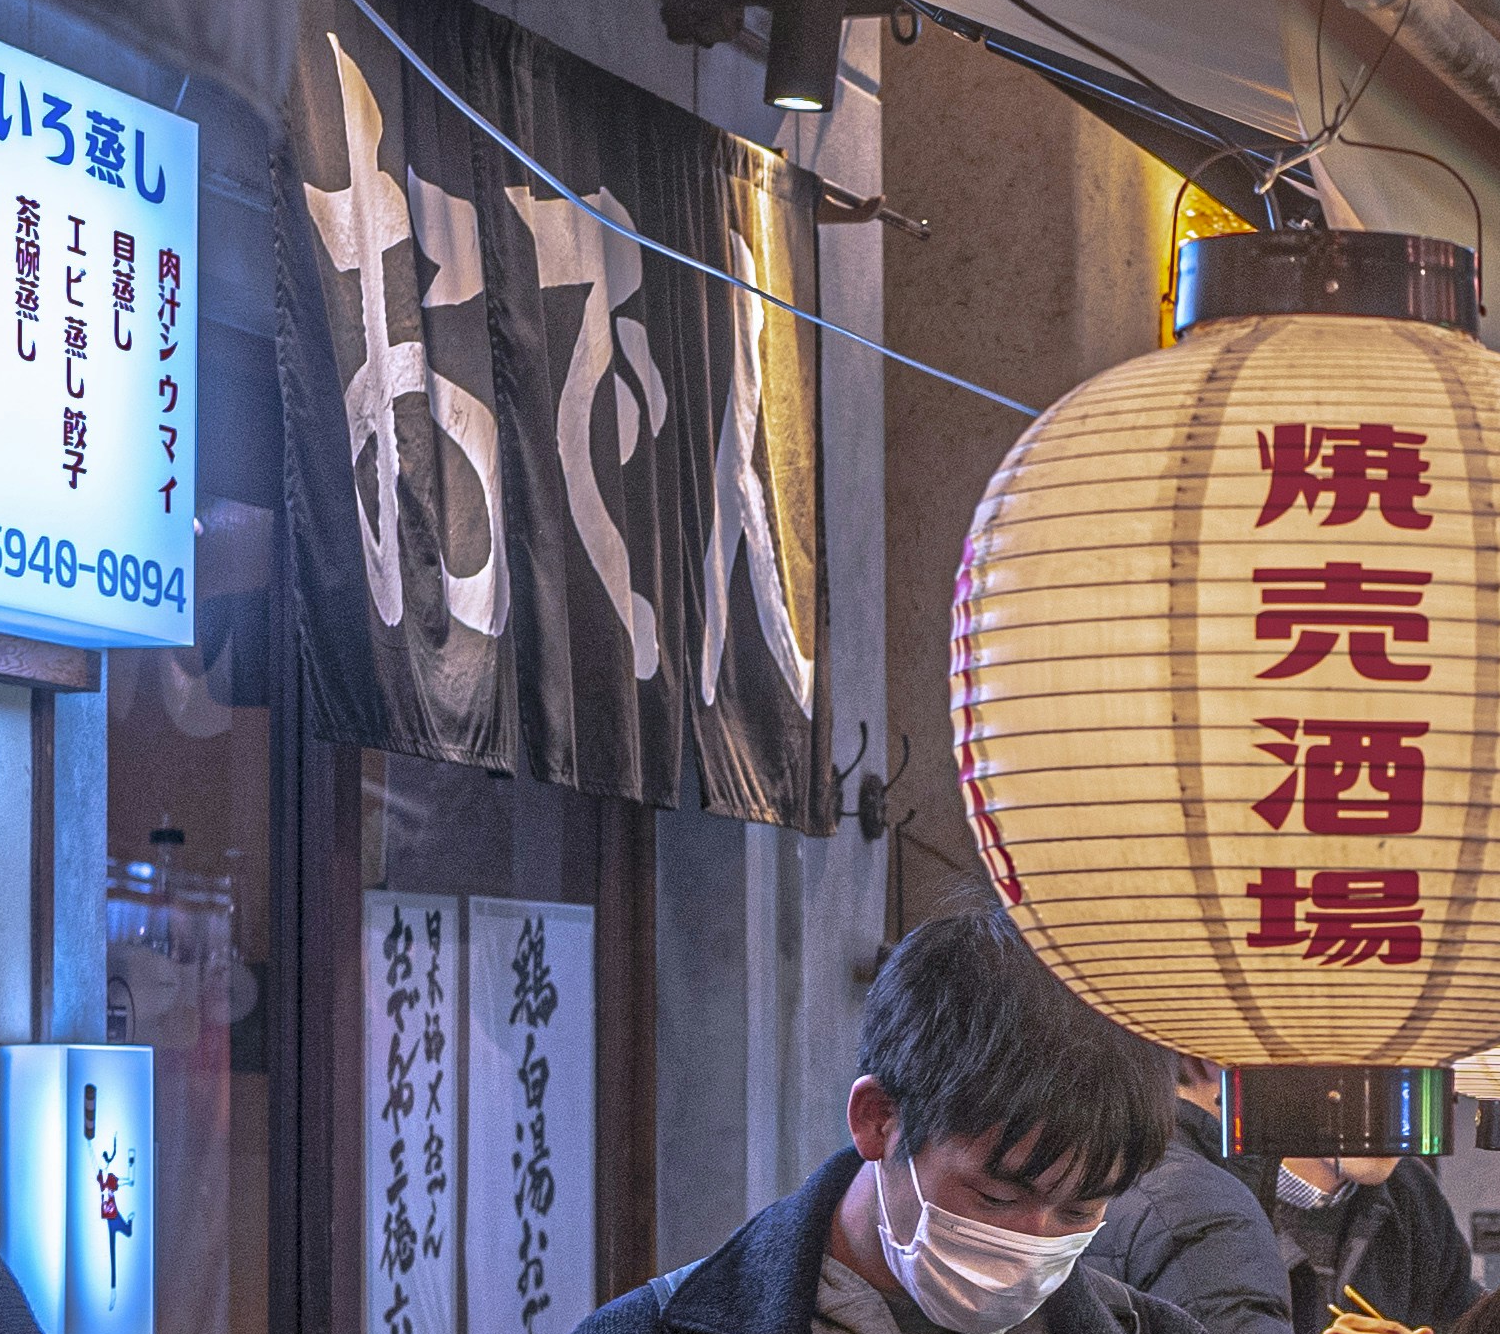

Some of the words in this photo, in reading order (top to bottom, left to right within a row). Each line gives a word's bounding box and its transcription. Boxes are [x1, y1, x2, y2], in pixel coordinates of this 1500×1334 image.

[14, 194, 42, 363] 茶碗蒸し
[112, 229, 136, 353] 貝蒸し
[1245, 422, 1434, 968] 焼売酒場
